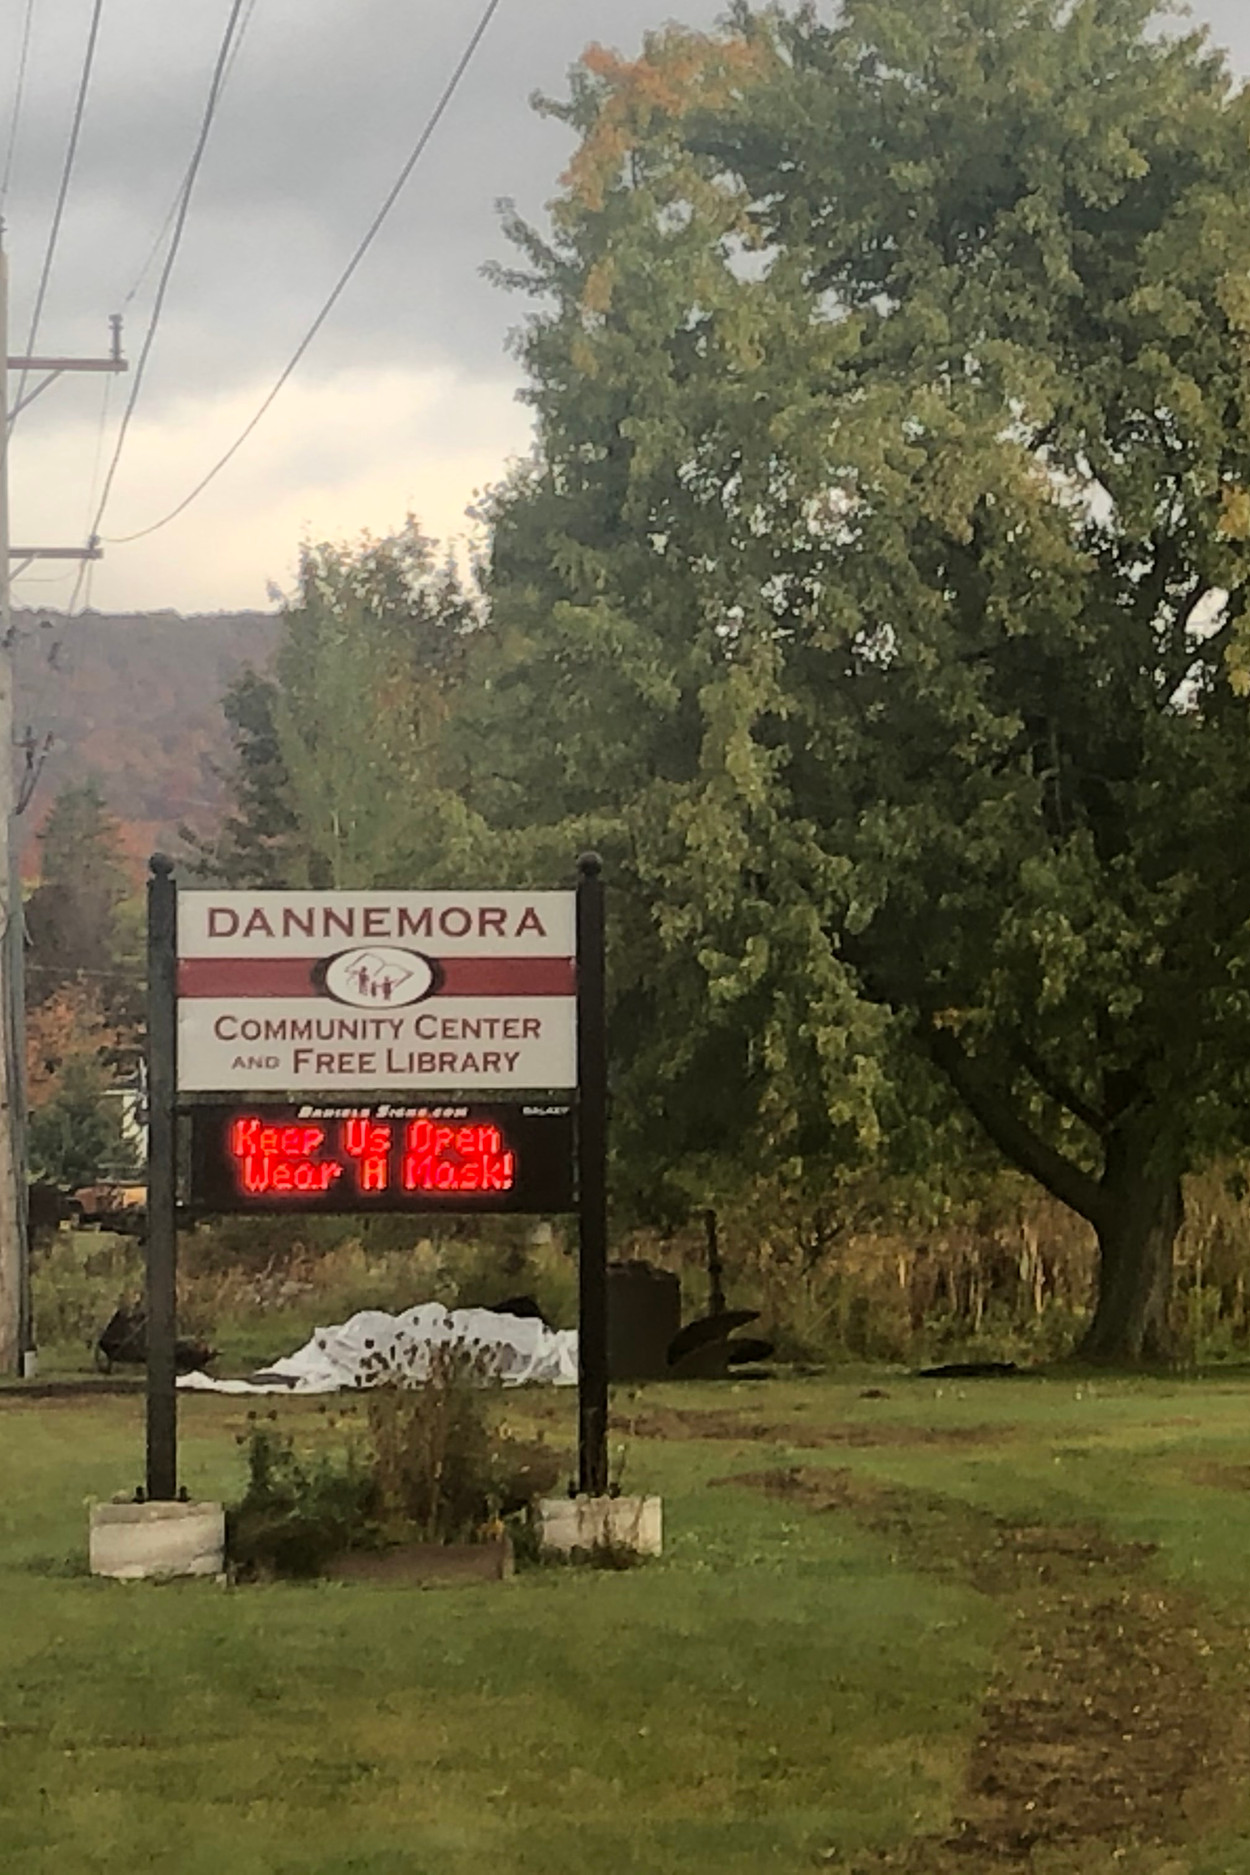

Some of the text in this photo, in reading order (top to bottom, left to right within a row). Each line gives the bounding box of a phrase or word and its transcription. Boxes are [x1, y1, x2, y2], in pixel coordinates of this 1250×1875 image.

[207, 906, 547, 938] DANNEMORA
[213, 1013, 542, 1041] COMMUNITY CENTER
[231, 1047, 521, 1074] AND FREE LIBRARY
[232, 1119, 325, 1156] Keep
[345, 1119, 392, 1155] Us
[243, 1151, 514, 1192] Wear A Mask!
